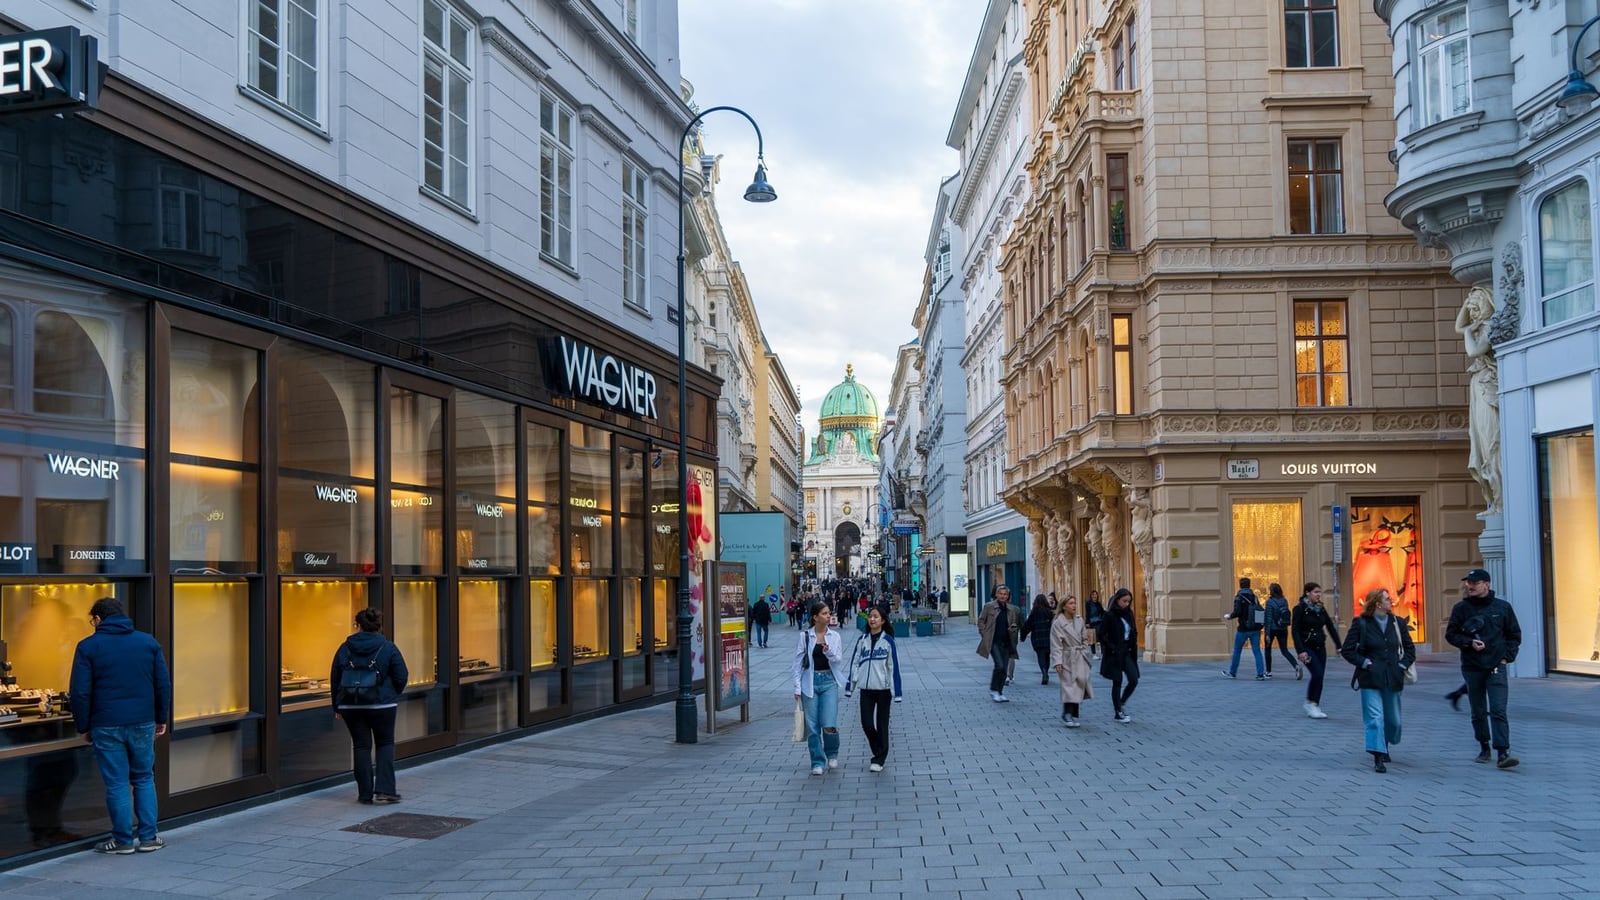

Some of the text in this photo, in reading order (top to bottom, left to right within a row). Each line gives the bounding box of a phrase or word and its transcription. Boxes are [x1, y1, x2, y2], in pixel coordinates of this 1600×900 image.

[560, 335, 658, 419] WAGNER
[48, 453, 119, 480] WAGNER
[1281, 463, 1377, 475] LOUIS VUITTON
[316, 485, 358, 503] WAGNER
[475, 503, 504, 518] WAGNER
[582, 515, 602, 527] WAGNER
[0, 546, 33, 560] LOT
[70, 550, 116, 560] LONGINES
[304, 553, 330, 566] Chopard
[467, 559, 488, 568] WAGNER
